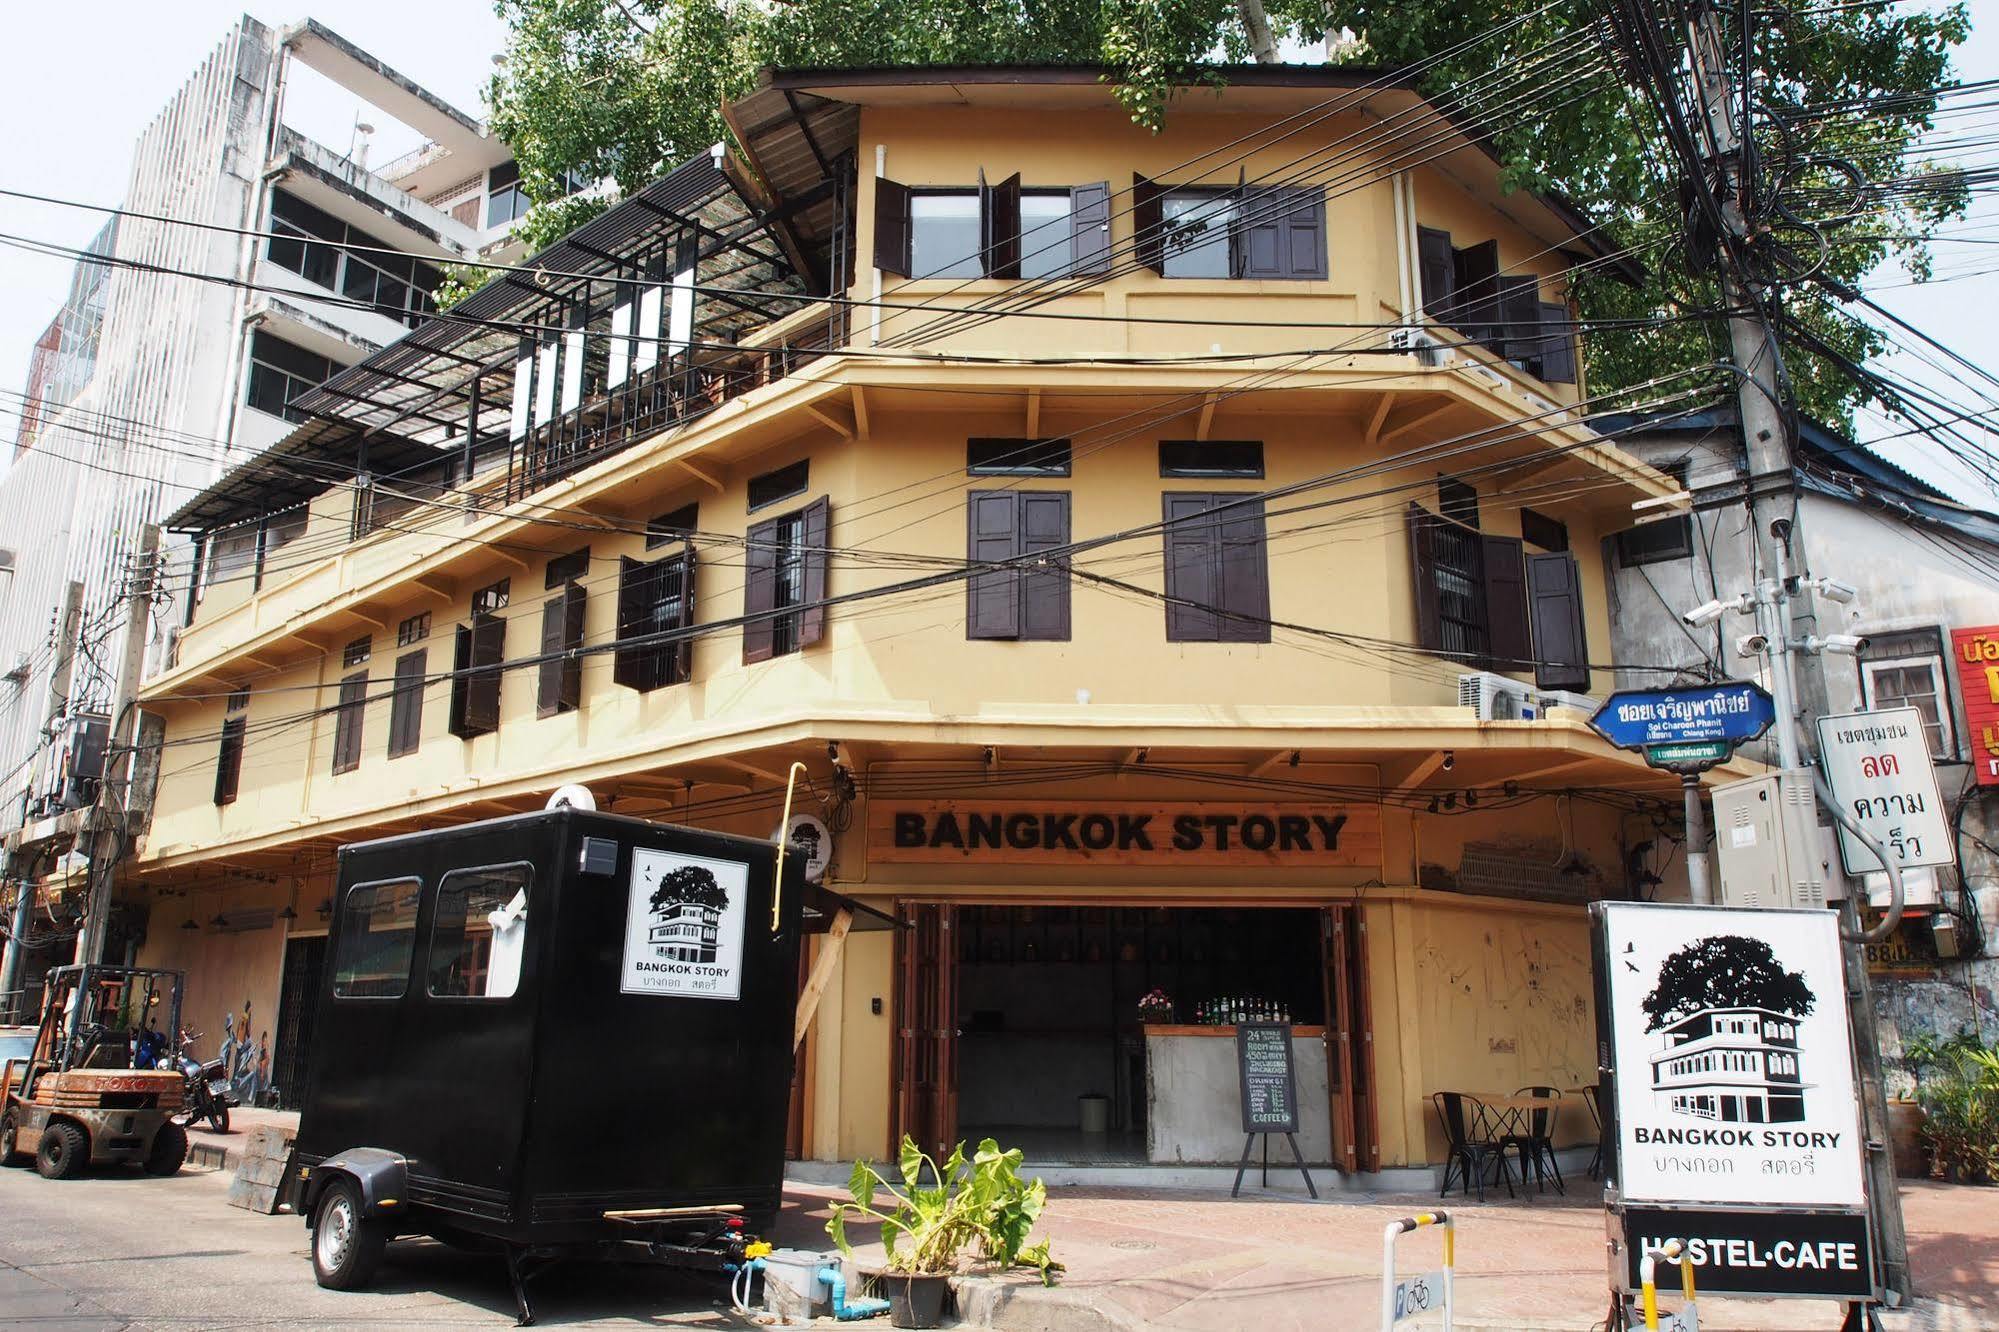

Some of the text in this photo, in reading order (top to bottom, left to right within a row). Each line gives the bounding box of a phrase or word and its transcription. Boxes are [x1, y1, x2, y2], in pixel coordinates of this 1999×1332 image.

[1648, 718, 1722, 731] Soi Charoen Phanit
[1837, 725, 1907, 746] เขตชุมชน
[1861, 754, 1899, 778] ลด
[1854, 793, 1925, 819] ความ
[894, 812, 1348, 851] BANGKOK STORY
[1880, 827, 1922, 859] ร็ว
[636, 962, 730, 977] BANGKOK STORY
[1252, 1113, 1282, 1123] COFFEE
[1634, 1127, 1841, 1149] BANGKOK STORY
[1655, 1151, 1816, 1176] บางกอก สตอรี่
